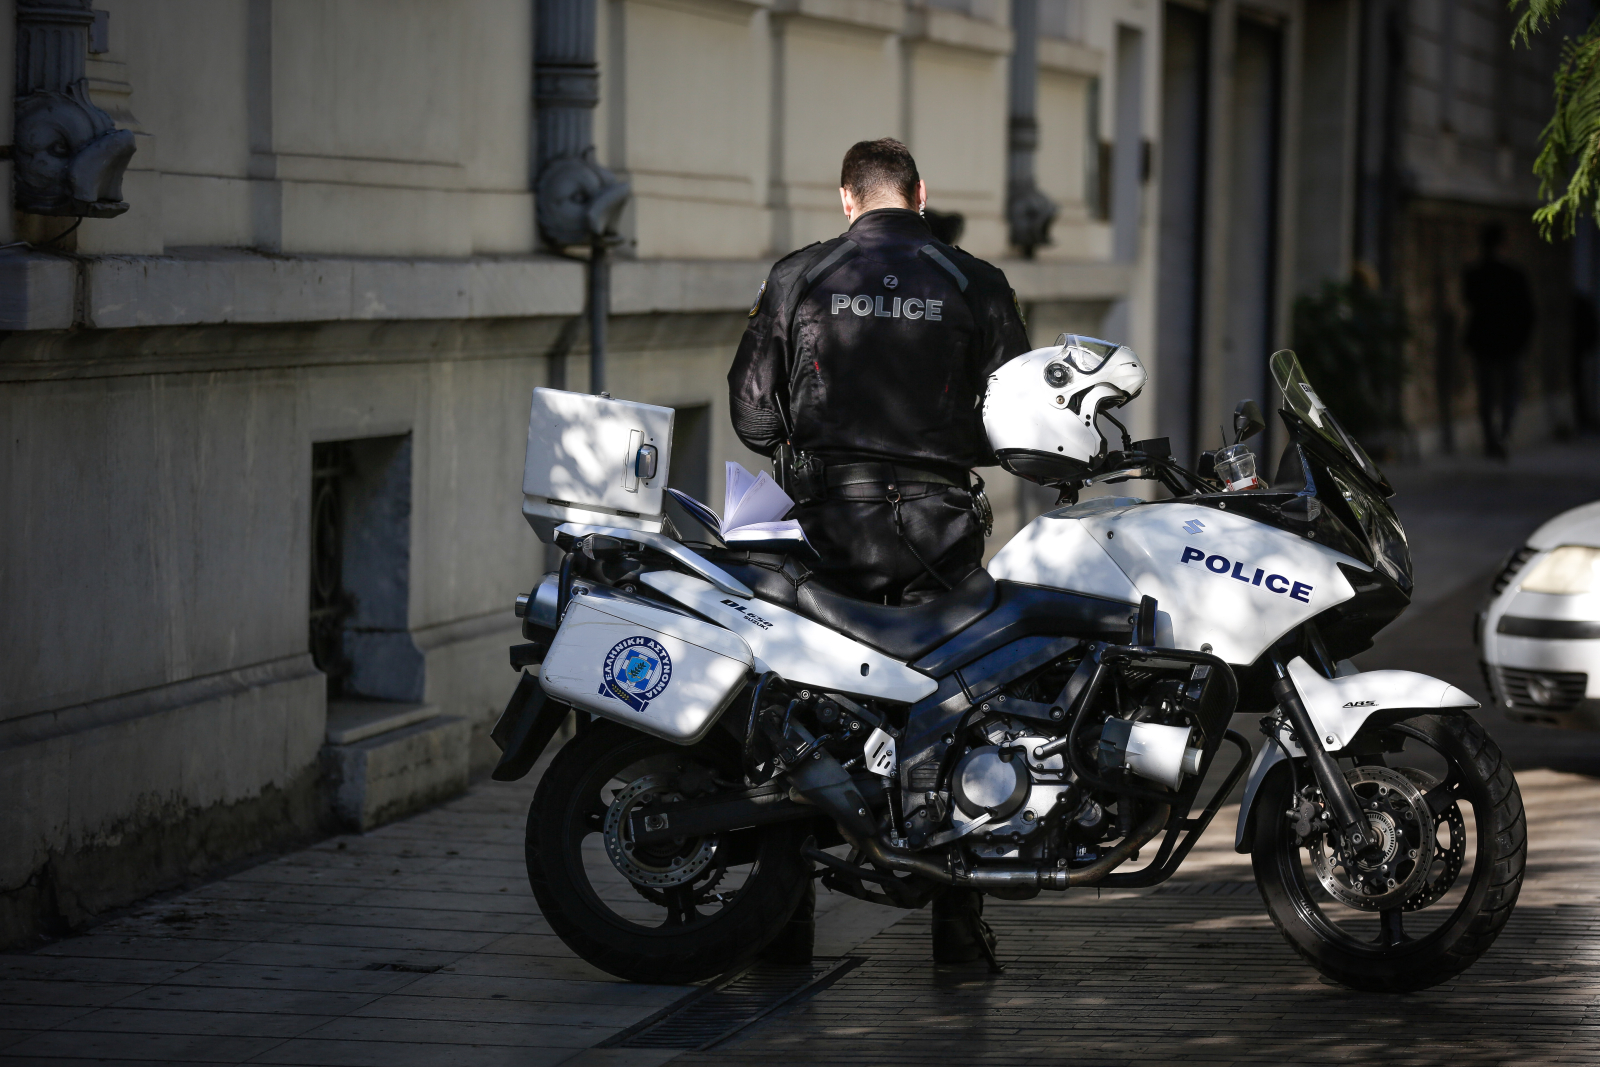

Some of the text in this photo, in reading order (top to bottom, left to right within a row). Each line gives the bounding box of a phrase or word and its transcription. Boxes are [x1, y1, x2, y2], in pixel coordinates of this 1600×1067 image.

[831, 293, 943, 321] POLICE
[1180, 546, 1313, 604] POLICE
[743, 615, 769, 631] SUZUKI
